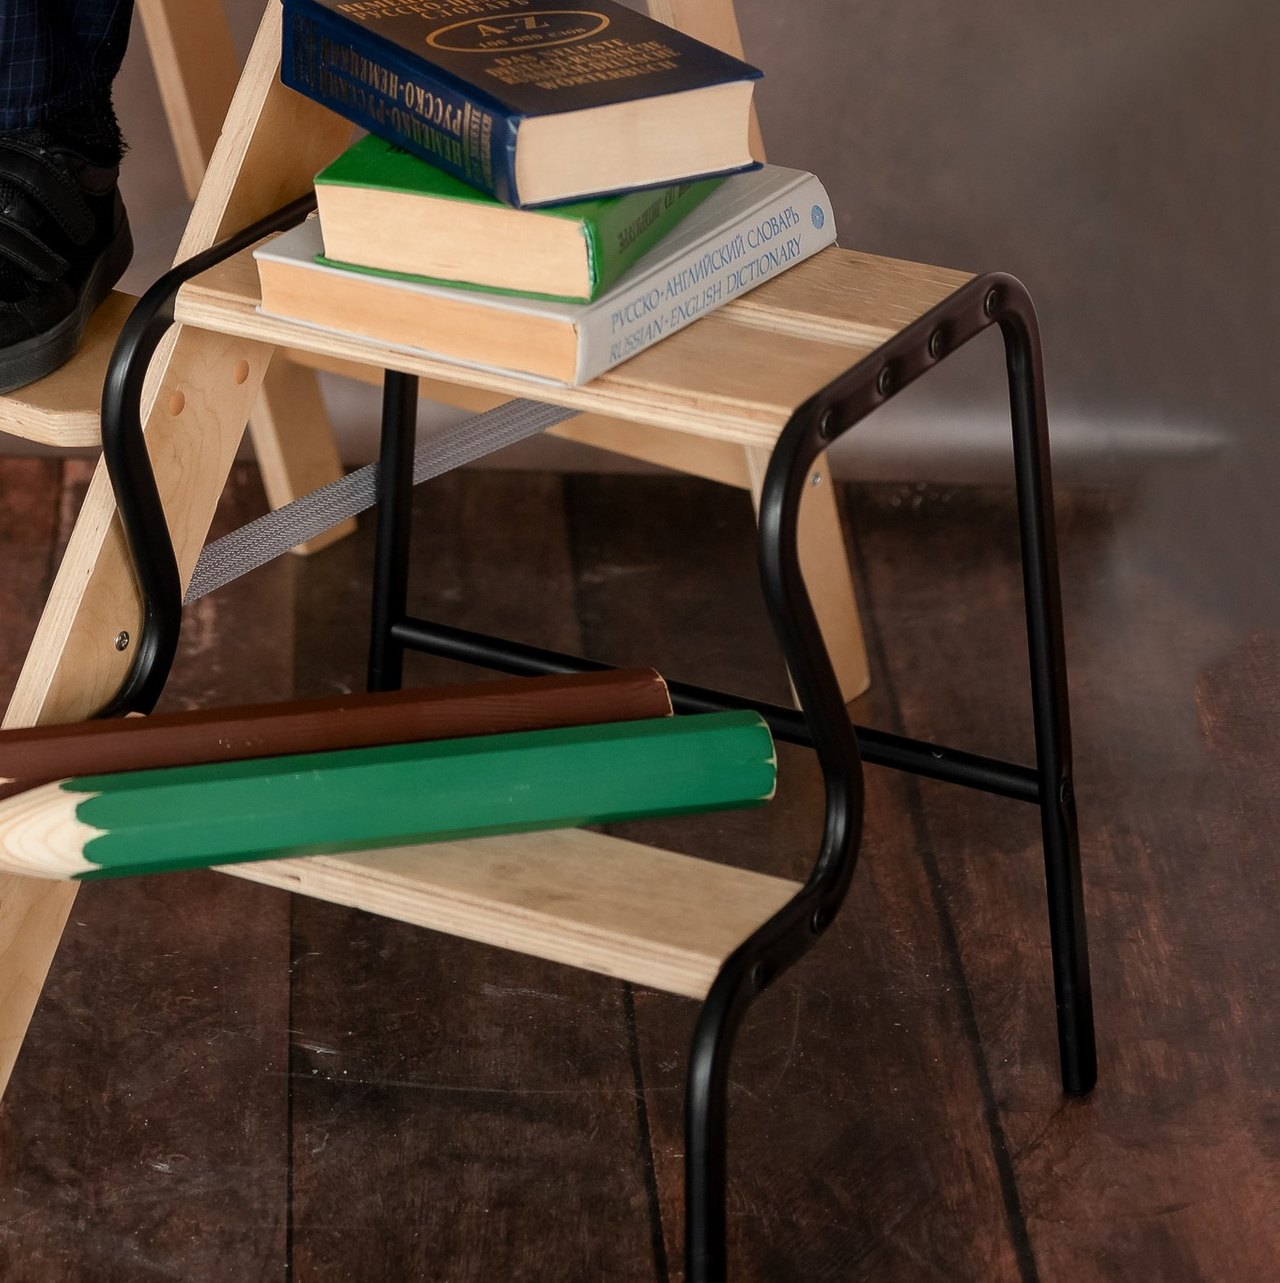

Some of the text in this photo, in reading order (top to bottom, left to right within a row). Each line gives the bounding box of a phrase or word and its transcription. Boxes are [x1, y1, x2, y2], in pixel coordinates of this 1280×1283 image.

[476, 15, 551, 37] A-Z
[478, 38, 509, 49] 100
[512, 33, 544, 44] 000
[748, 206, 800, 249] СЛОВАРЬ
[726, 233, 802, 295] DICTIONARY
